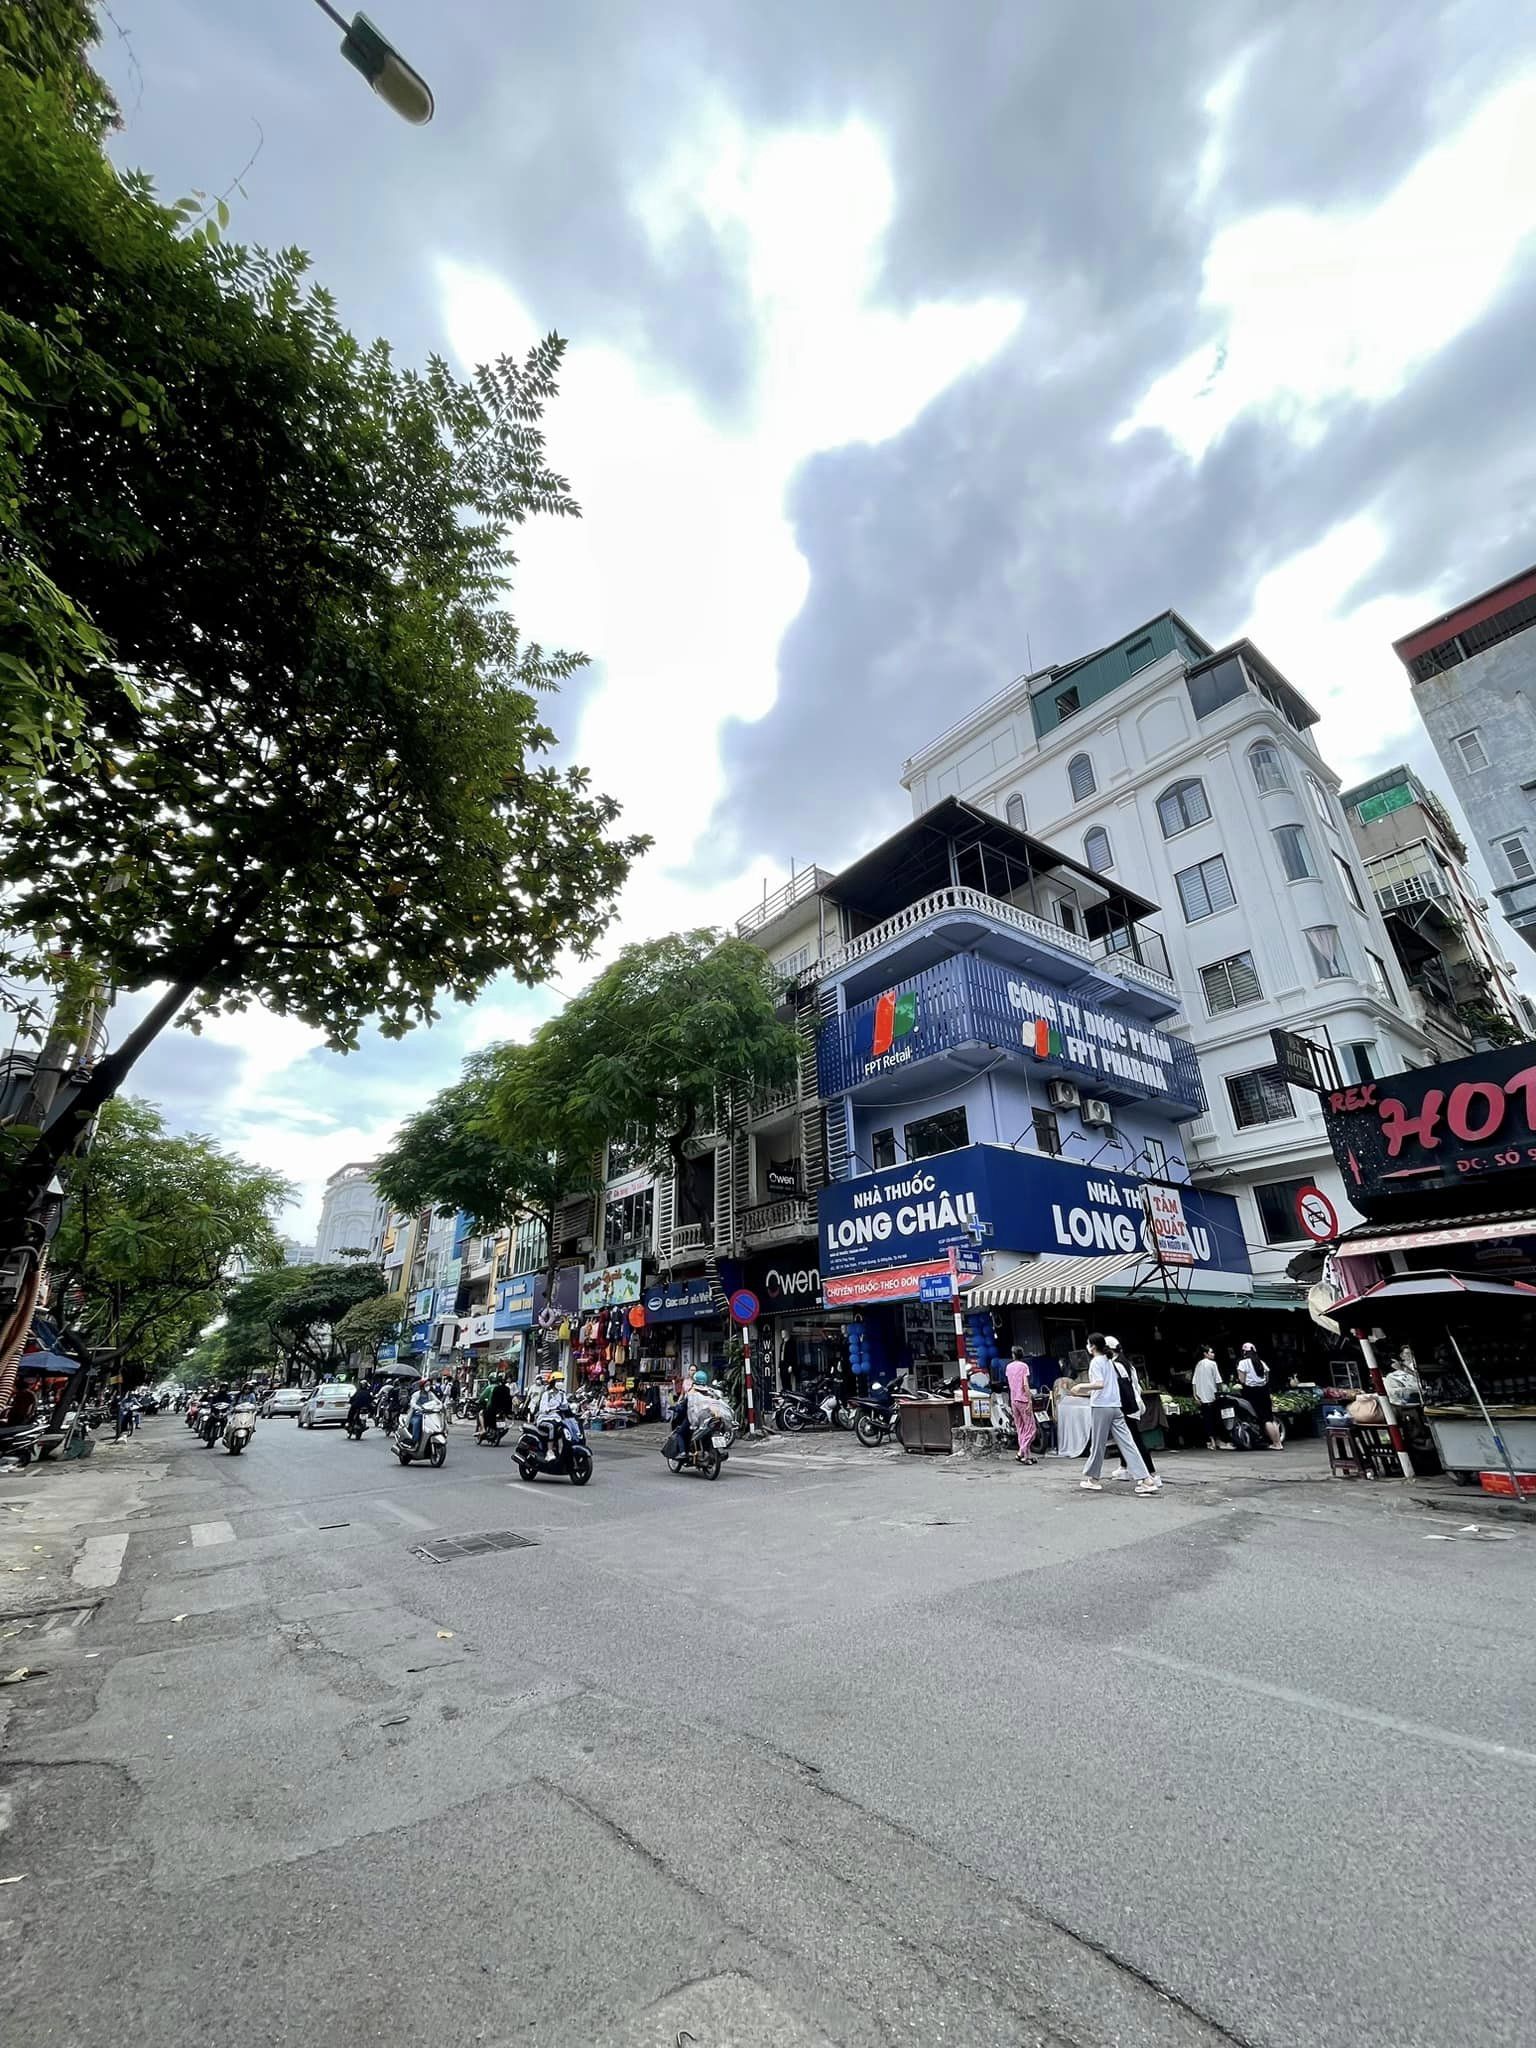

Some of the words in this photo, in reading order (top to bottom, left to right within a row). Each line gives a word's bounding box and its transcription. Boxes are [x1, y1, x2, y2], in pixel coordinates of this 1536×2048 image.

[1007, 981, 1057, 1022] CÔNG
[1058, 1000, 1081, 1030] TY
[1083, 1009, 1127, 1048] DƯỢC
[1128, 1028, 1174, 1064] PHẨM
[865, 1058, 881, 1076] FPT
[883, 1045, 910, 1069] Retail
[1066, 1036, 1098, 1069] FPT
[1100, 1047, 1168, 1091] PHARMA
[1329, 1084, 1377, 1114] REX
[769, 1172, 794, 1185] Owen
[853, 1185, 883, 1209] NHÀ
[884, 1170, 936, 1202] THUỐC
[1086, 1179, 1122, 1207] NHÀ
[827, 1211, 893, 1250] LONG
[896, 1190, 976, 1236] CHÂU
[1052, 1204, 1137, 1253] LONG
[766, 1268, 820, 1298] Owen
[854, 1279, 879, 1295] THUỐC
[880, 1278, 900, 1290] THEO
[901, 1276, 919, 1288] ĐƠN
